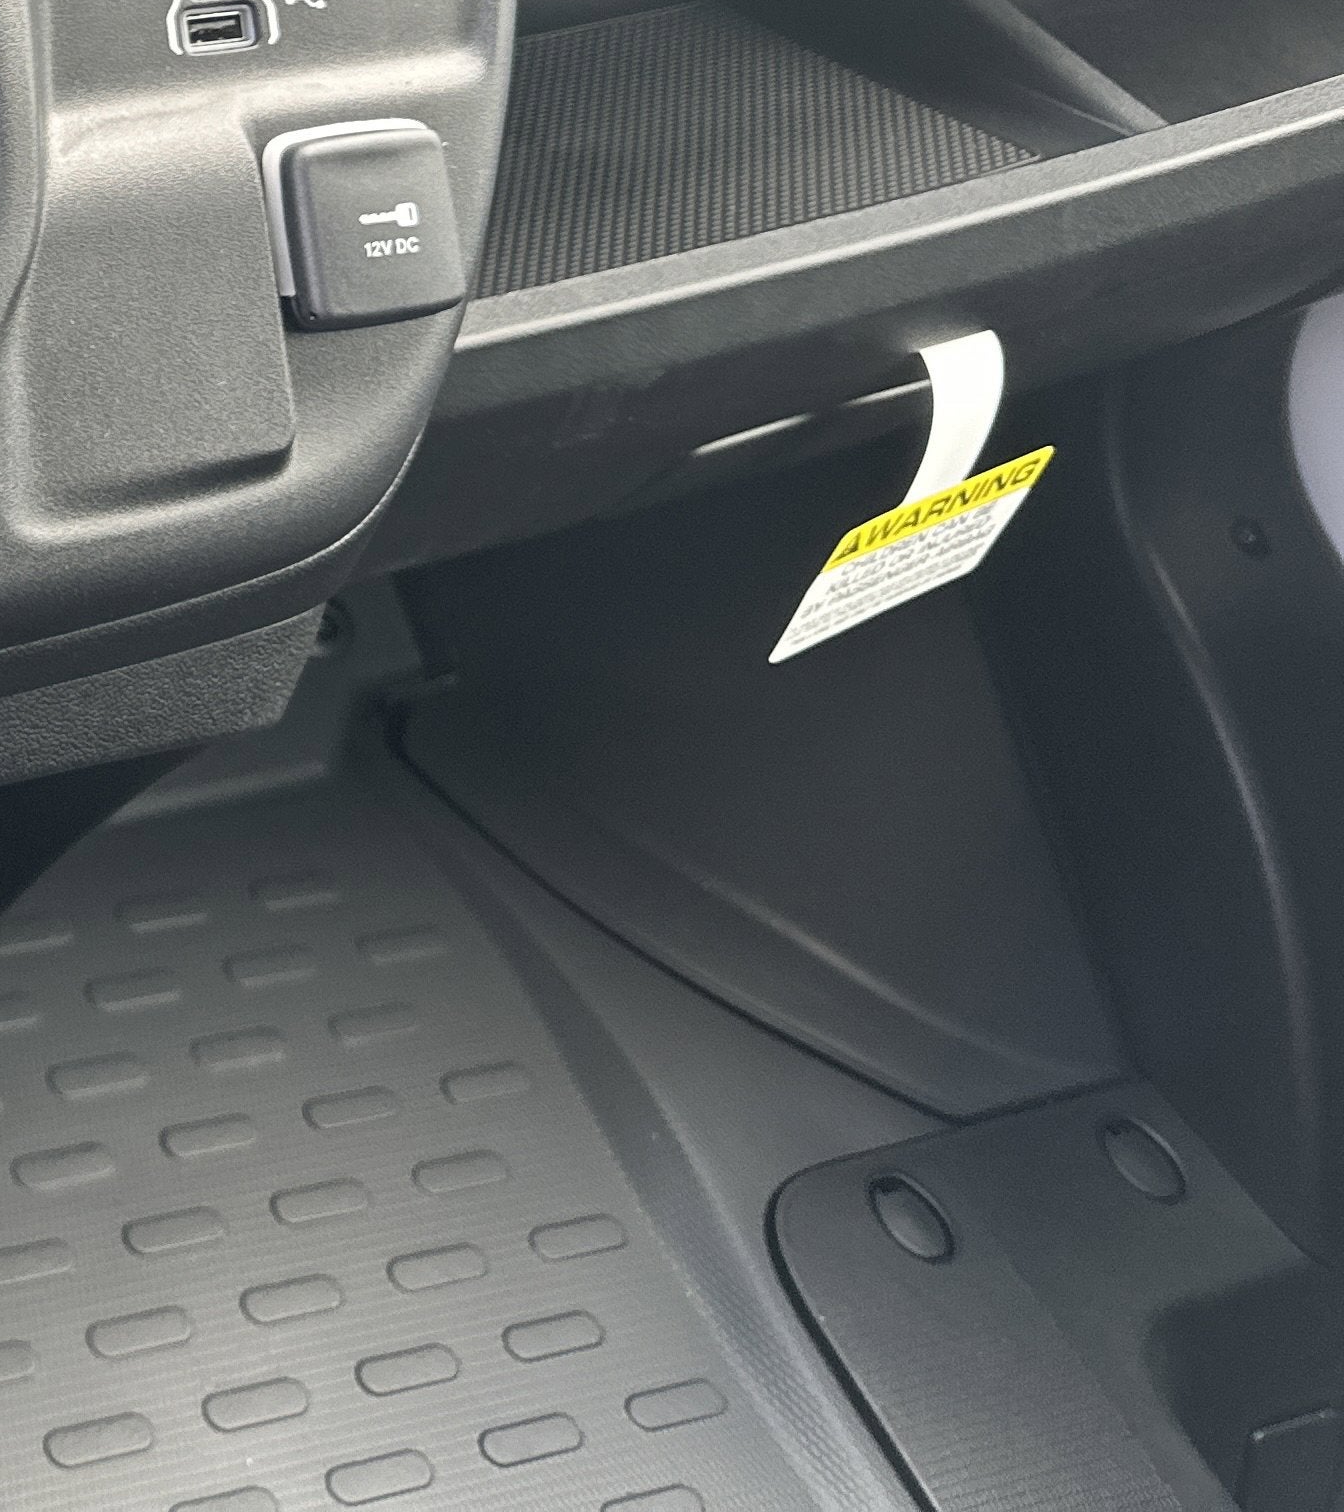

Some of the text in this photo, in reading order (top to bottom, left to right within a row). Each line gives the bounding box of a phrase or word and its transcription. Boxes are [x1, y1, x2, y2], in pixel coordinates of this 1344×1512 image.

[364, 236, 420, 258] 12V DC
[865, 457, 1041, 547] WARNING
